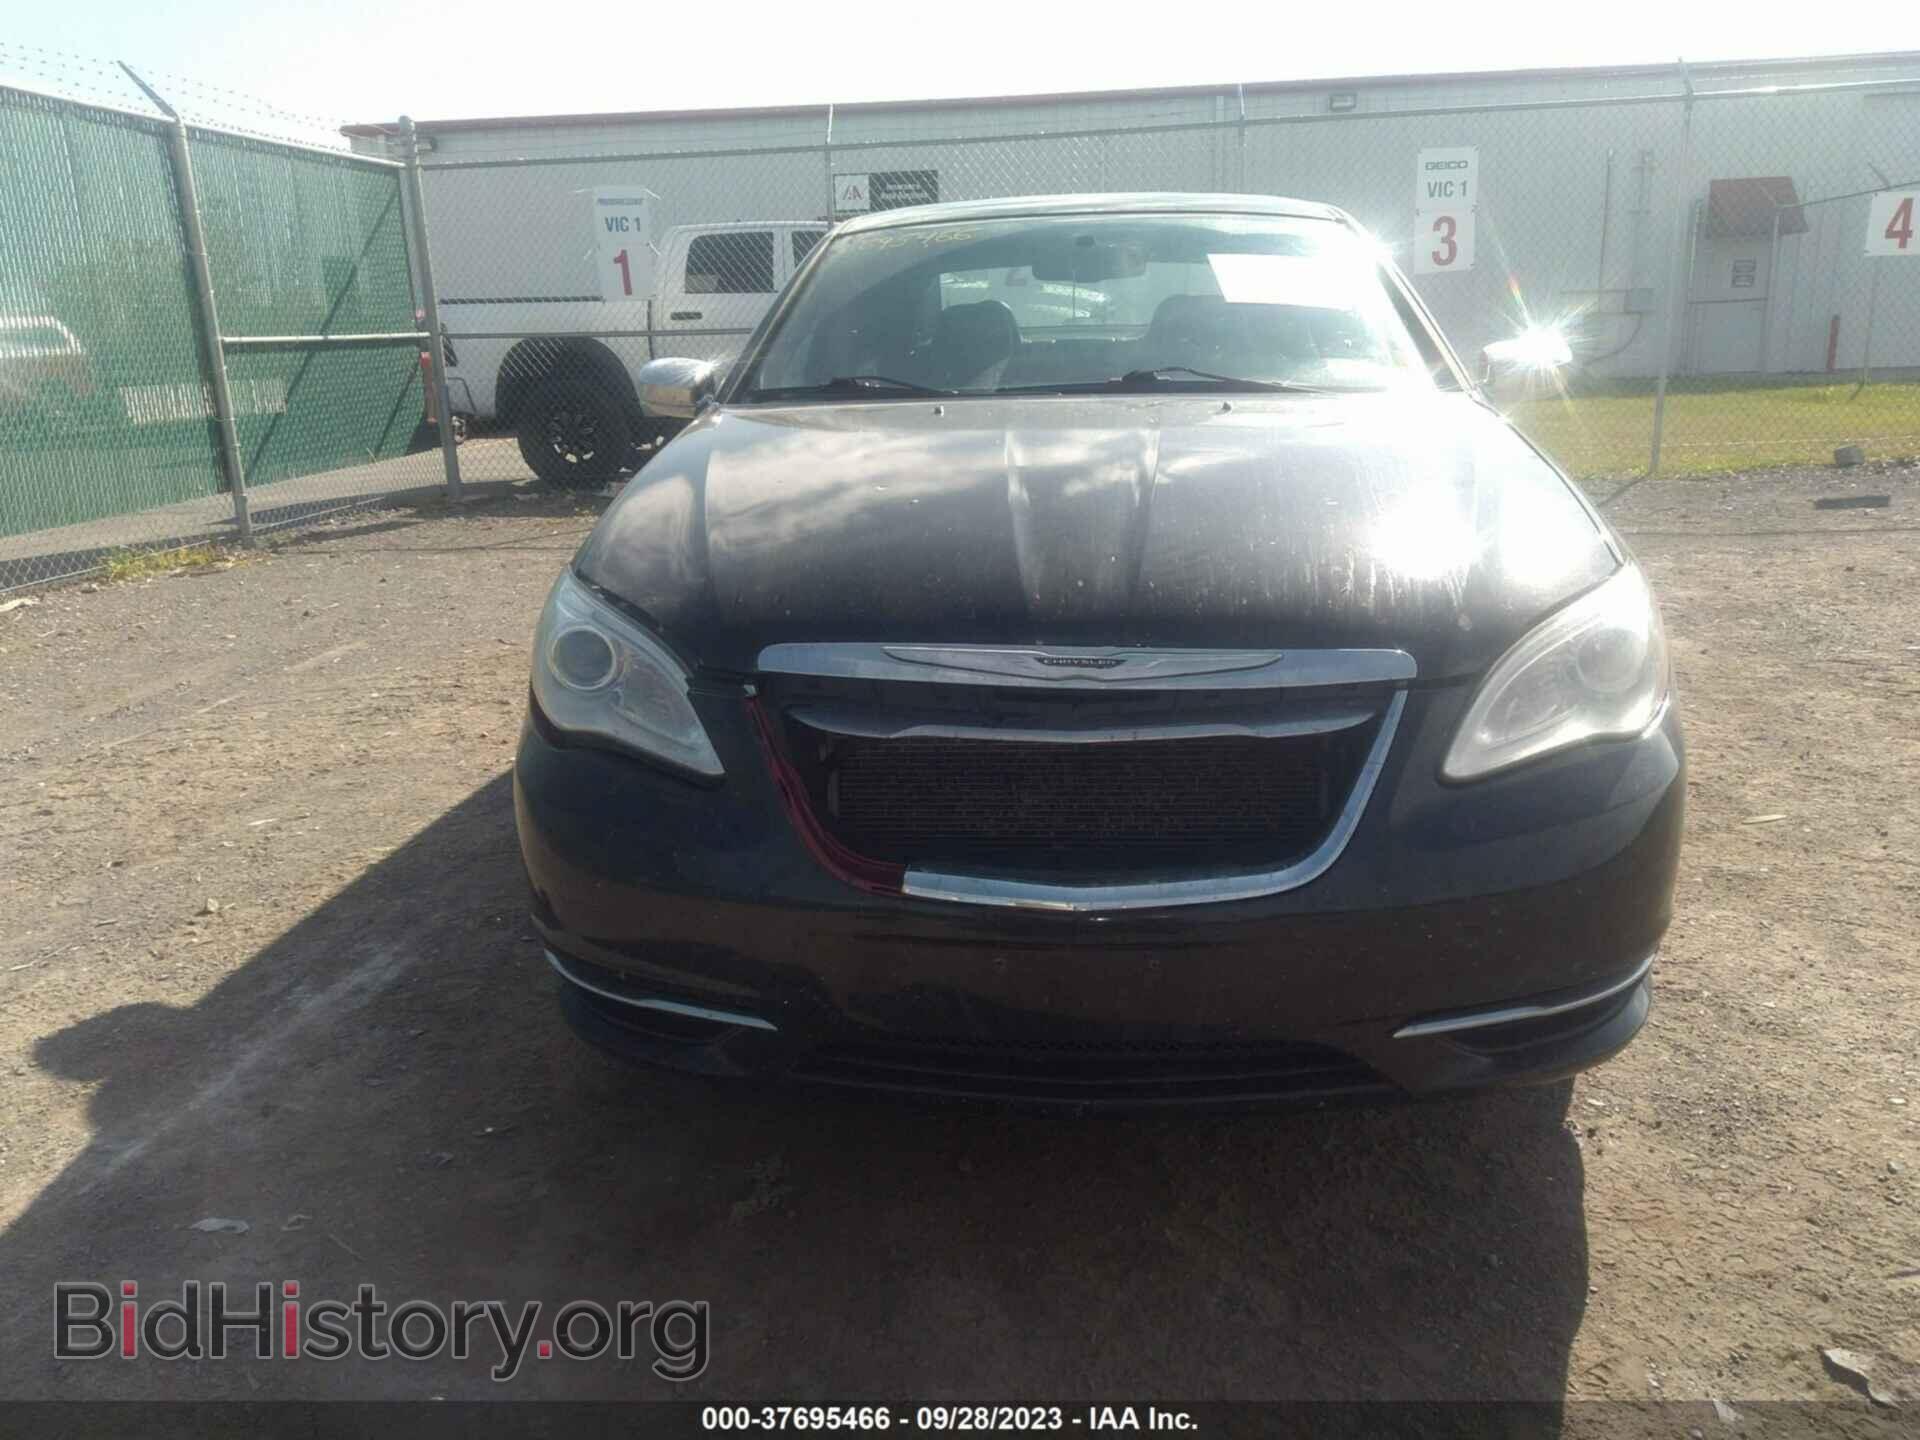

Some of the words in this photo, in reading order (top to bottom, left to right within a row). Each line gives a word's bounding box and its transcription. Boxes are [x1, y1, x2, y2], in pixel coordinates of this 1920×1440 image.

[1427, 181, 1454, 198] VIC
[1460, 181, 1466, 197] 1
[604, 216, 630, 233] VIC
[633, 217, 641, 233] 1
[1431, 215, 1457, 266] 3
[1884, 197, 1914, 249] 4
[613, 249, 632, 296] 1
